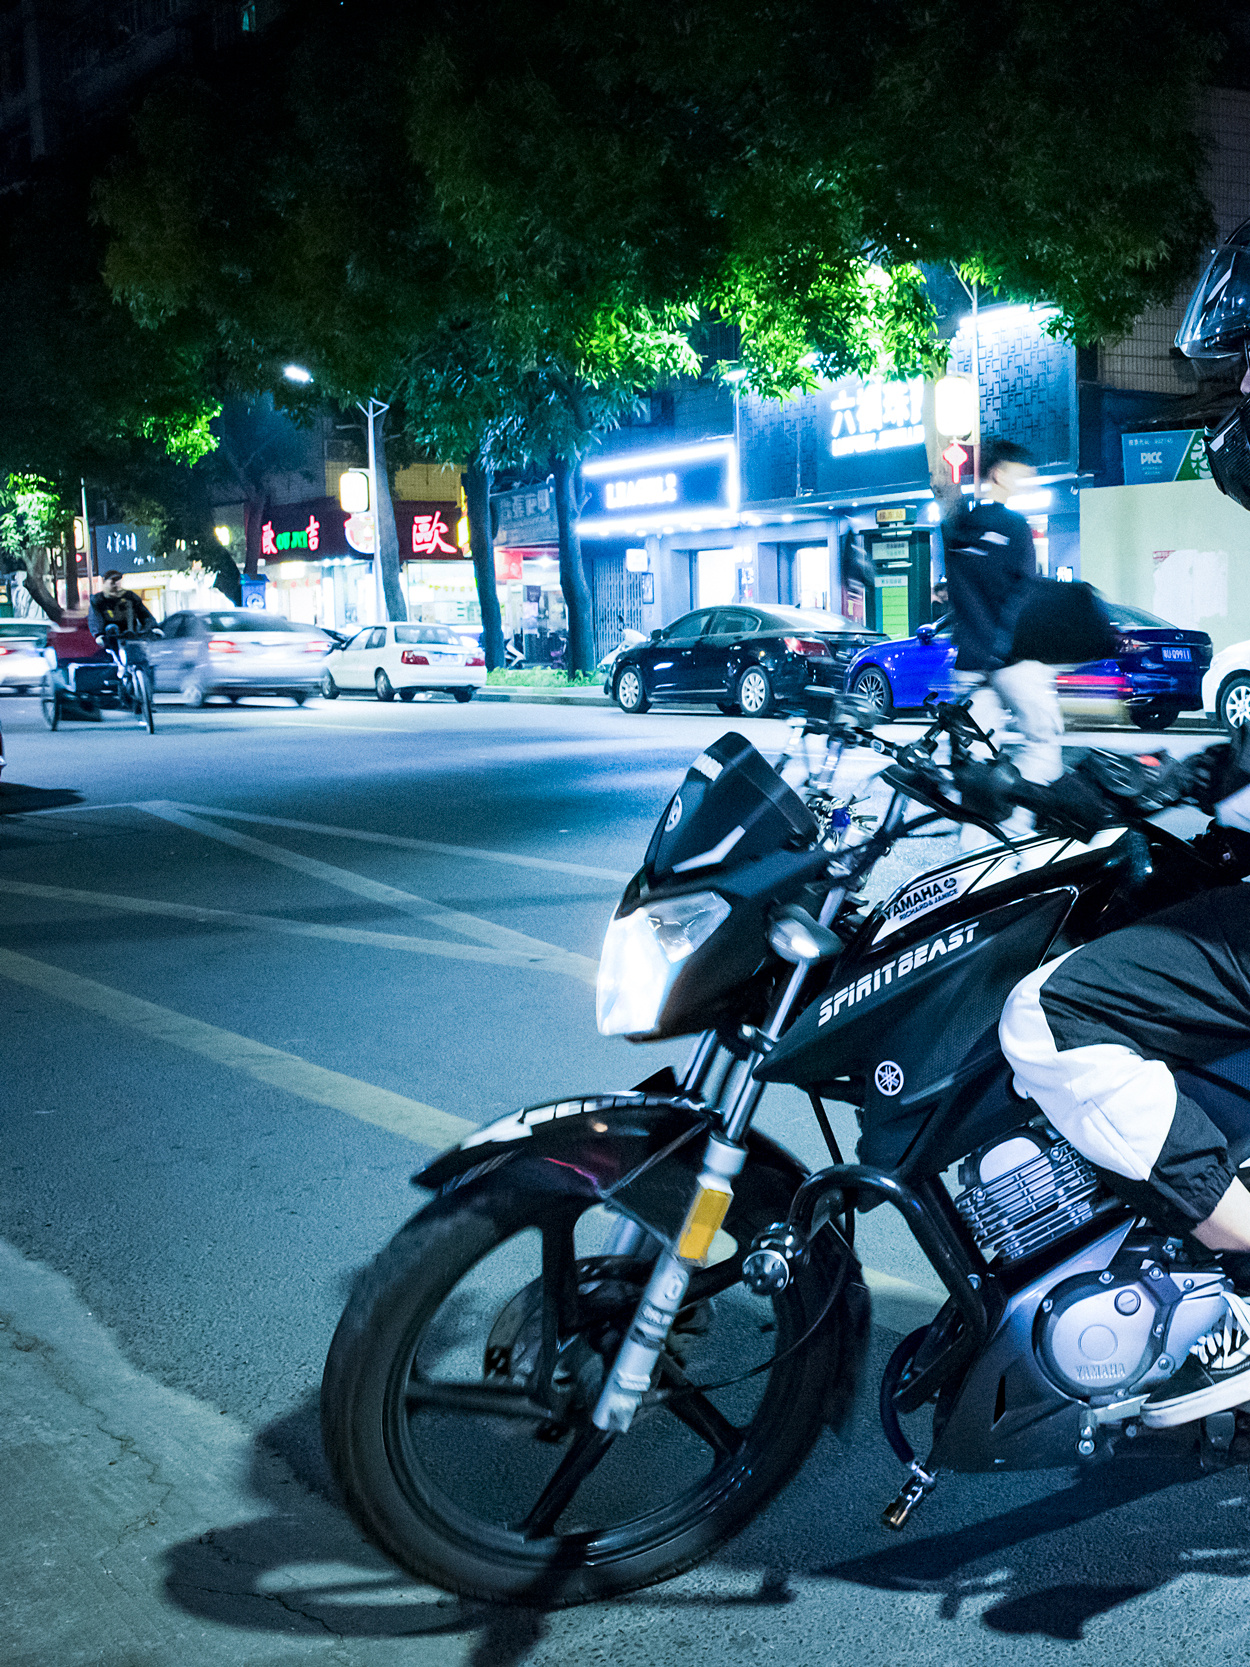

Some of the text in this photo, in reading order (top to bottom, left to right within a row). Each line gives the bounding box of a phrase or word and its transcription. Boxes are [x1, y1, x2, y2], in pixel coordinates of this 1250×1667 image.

[1140, 451, 1163, 465] PICC
[883, 882, 943, 921] YAMAHA
[817, 920, 980, 1028] SPIRIT BEAST
[1075, 1362, 1126, 1381] YAMAHA
